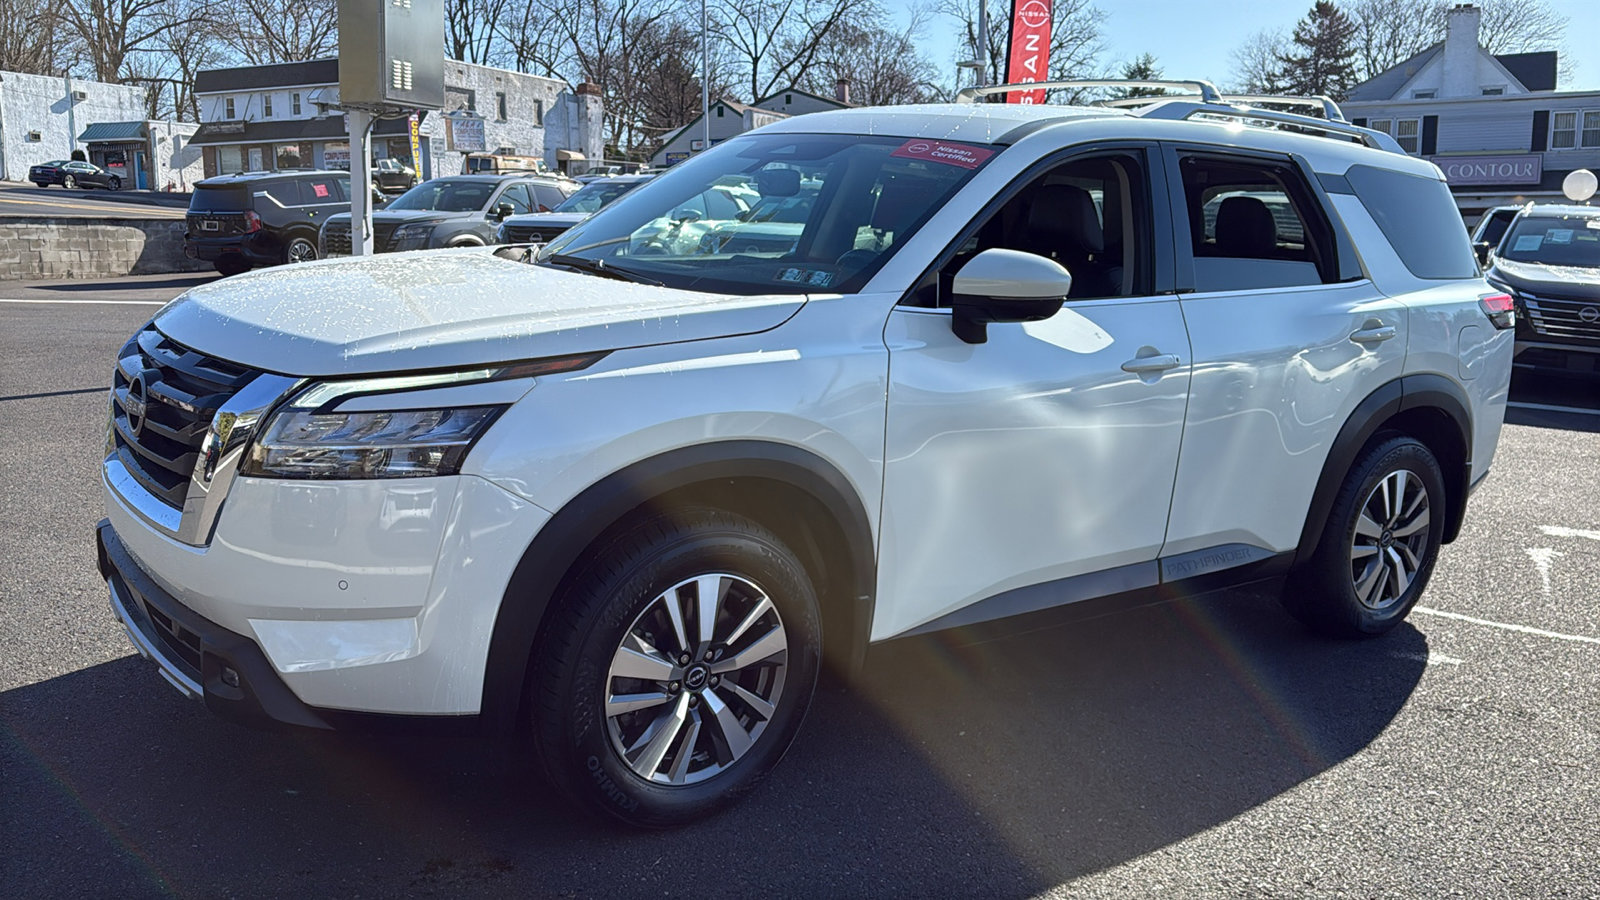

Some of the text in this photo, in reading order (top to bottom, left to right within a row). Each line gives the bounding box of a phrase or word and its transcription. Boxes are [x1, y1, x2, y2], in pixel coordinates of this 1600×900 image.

[411, 121, 421, 178] COMPUTER
[931, 151, 977, 163] Certified
[937, 146, 972, 156] Nissan
[1447, 163, 1532, 178] CONTOUR
[1166, 548, 1251, 575] PATHFINDER
